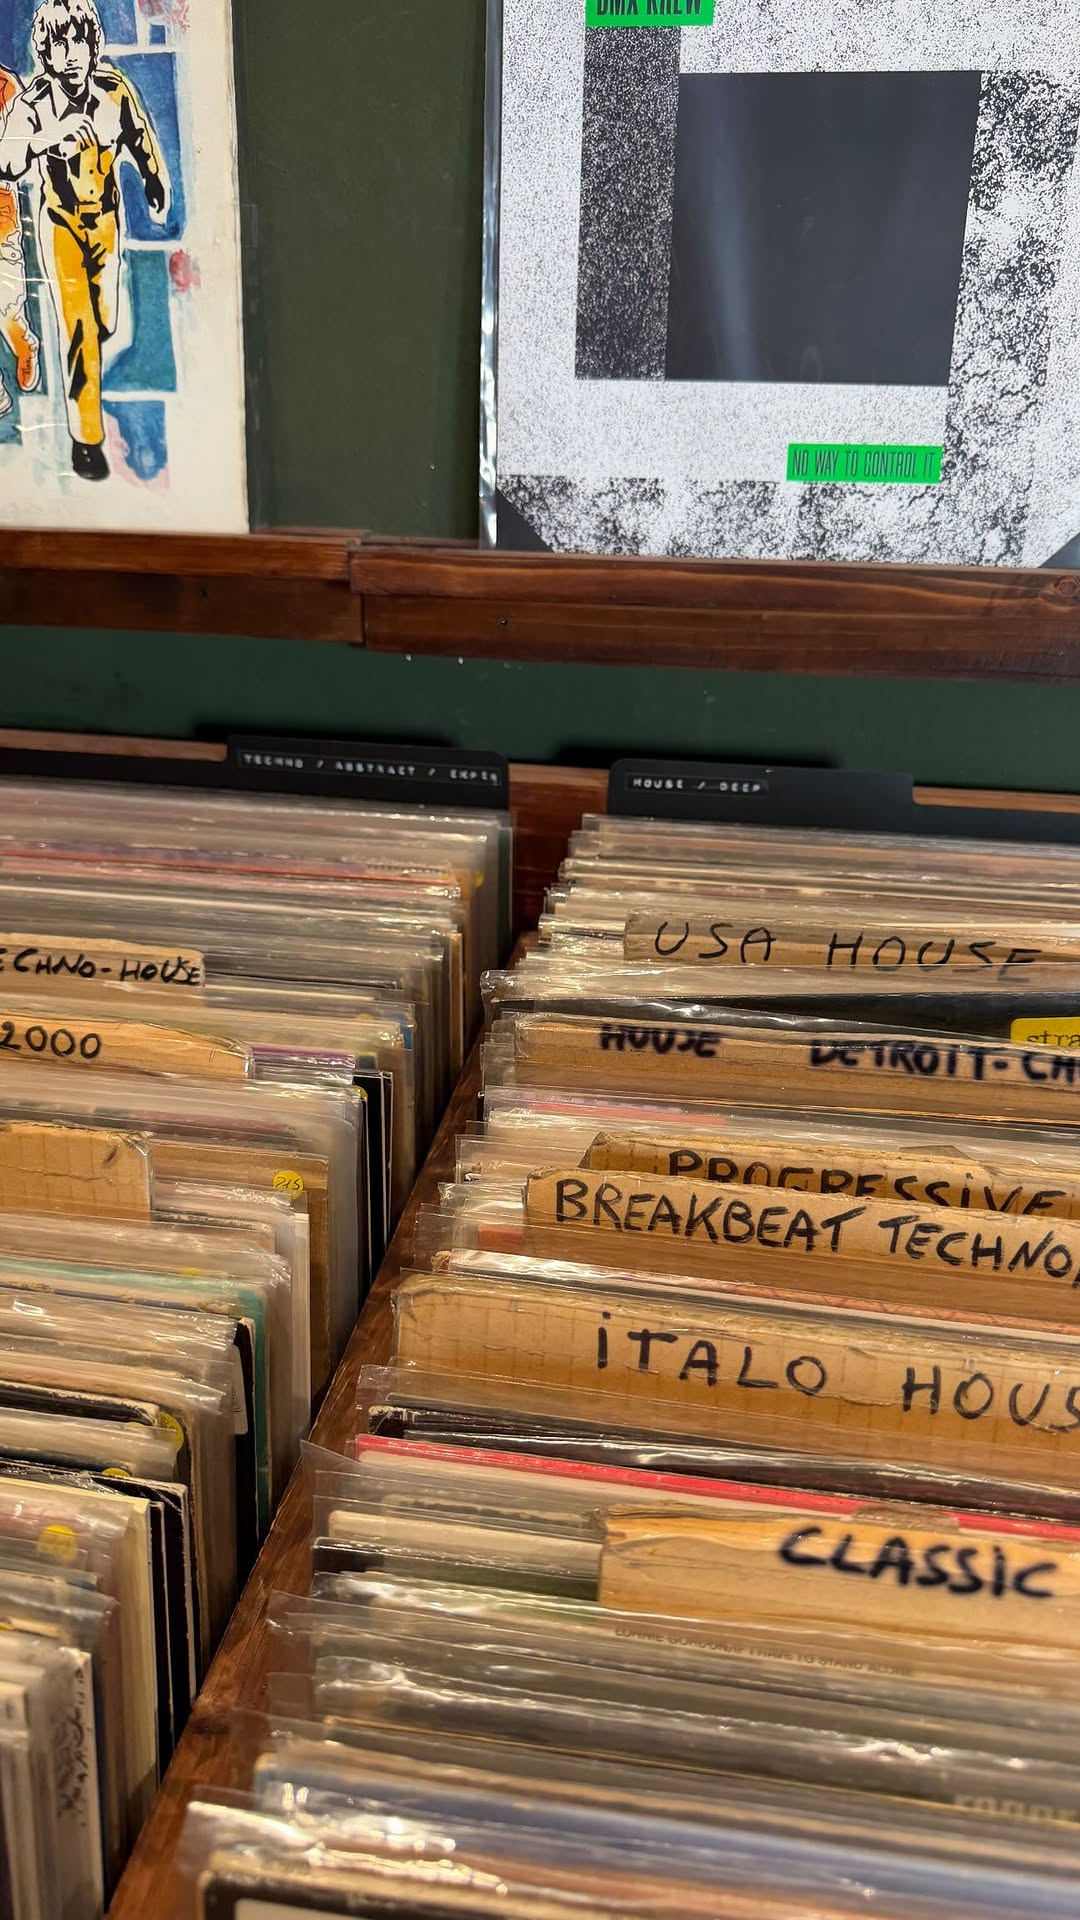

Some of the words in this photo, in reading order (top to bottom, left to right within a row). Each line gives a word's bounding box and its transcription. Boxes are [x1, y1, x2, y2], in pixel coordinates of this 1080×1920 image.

[792, 449, 809, 476] NO
[815, 450, 839, 476] WAY
[845, 451, 859, 477] TO
[864, 451, 917, 478] CONTROL
[923, 452, 937, 479] IT
[243, 753, 304, 768] TECHNO
[336, 761, 416, 776] ABSTRACT
[633, 778, 684, 789] HOUSE
[719, 781, 761, 792] DEEP
[654, 921, 777, 963] USA
[826, 931, 1042, 983] HOUSE
[0, 1021, 102, 1060] 2000
[556, 1178, 867, 1252] BREAKBEAT
[779, 1526, 1058, 1598] CLASSIC
